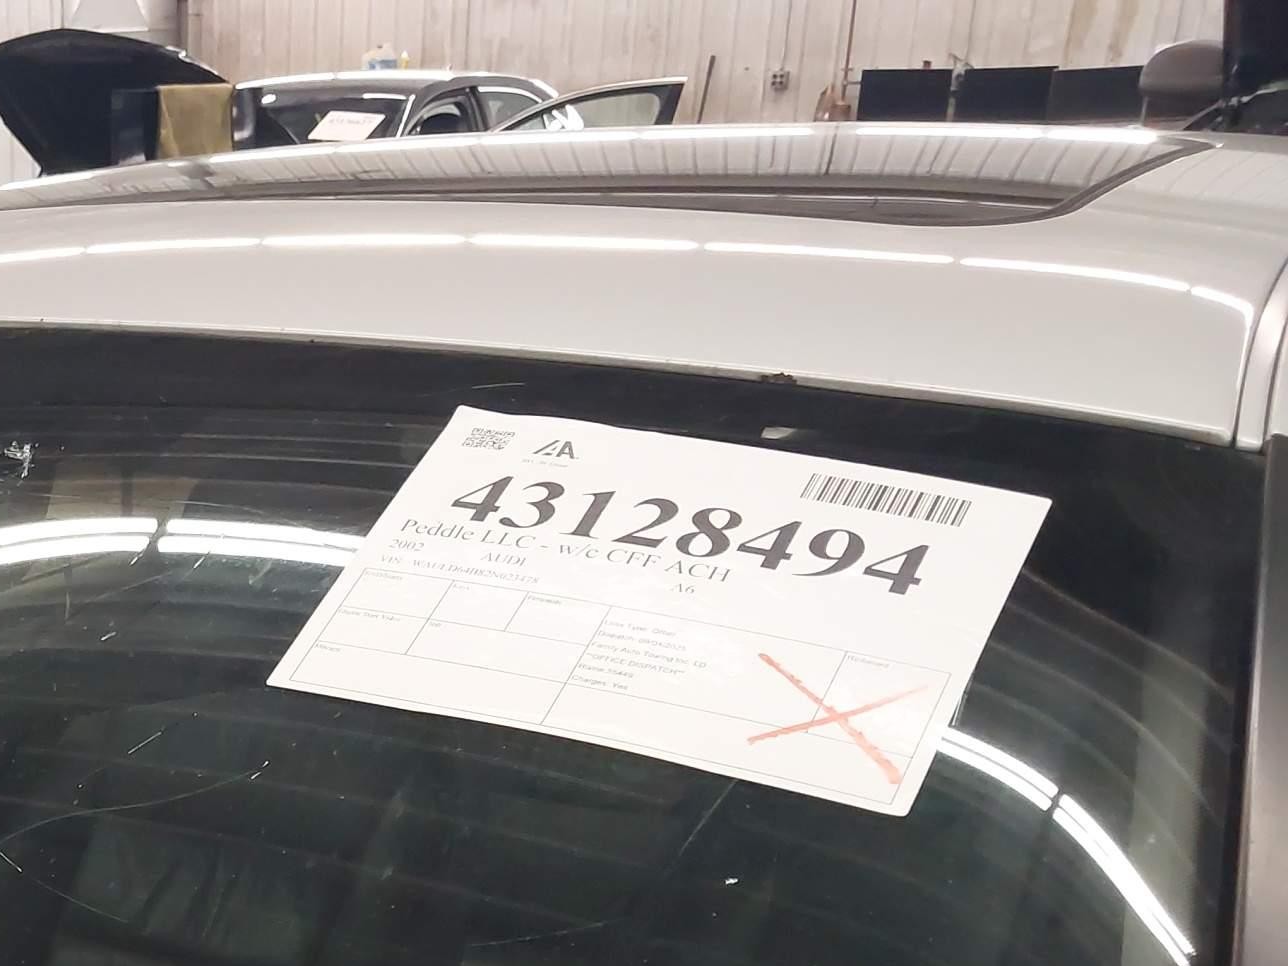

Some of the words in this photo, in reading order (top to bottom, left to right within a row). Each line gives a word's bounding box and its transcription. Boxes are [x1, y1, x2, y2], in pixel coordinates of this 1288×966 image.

[388, 538, 425, 552] 2002
[480, 551, 527, 567] AUDI
[669, 582, 695, 594] A6
[400, 519, 474, 540] Peddle
[480, 529, 536, 548] LLC
[606, 548, 661, 568] CFF
[665, 559, 733, 583] ACH
[451, 475, 929, 595] 43128494
